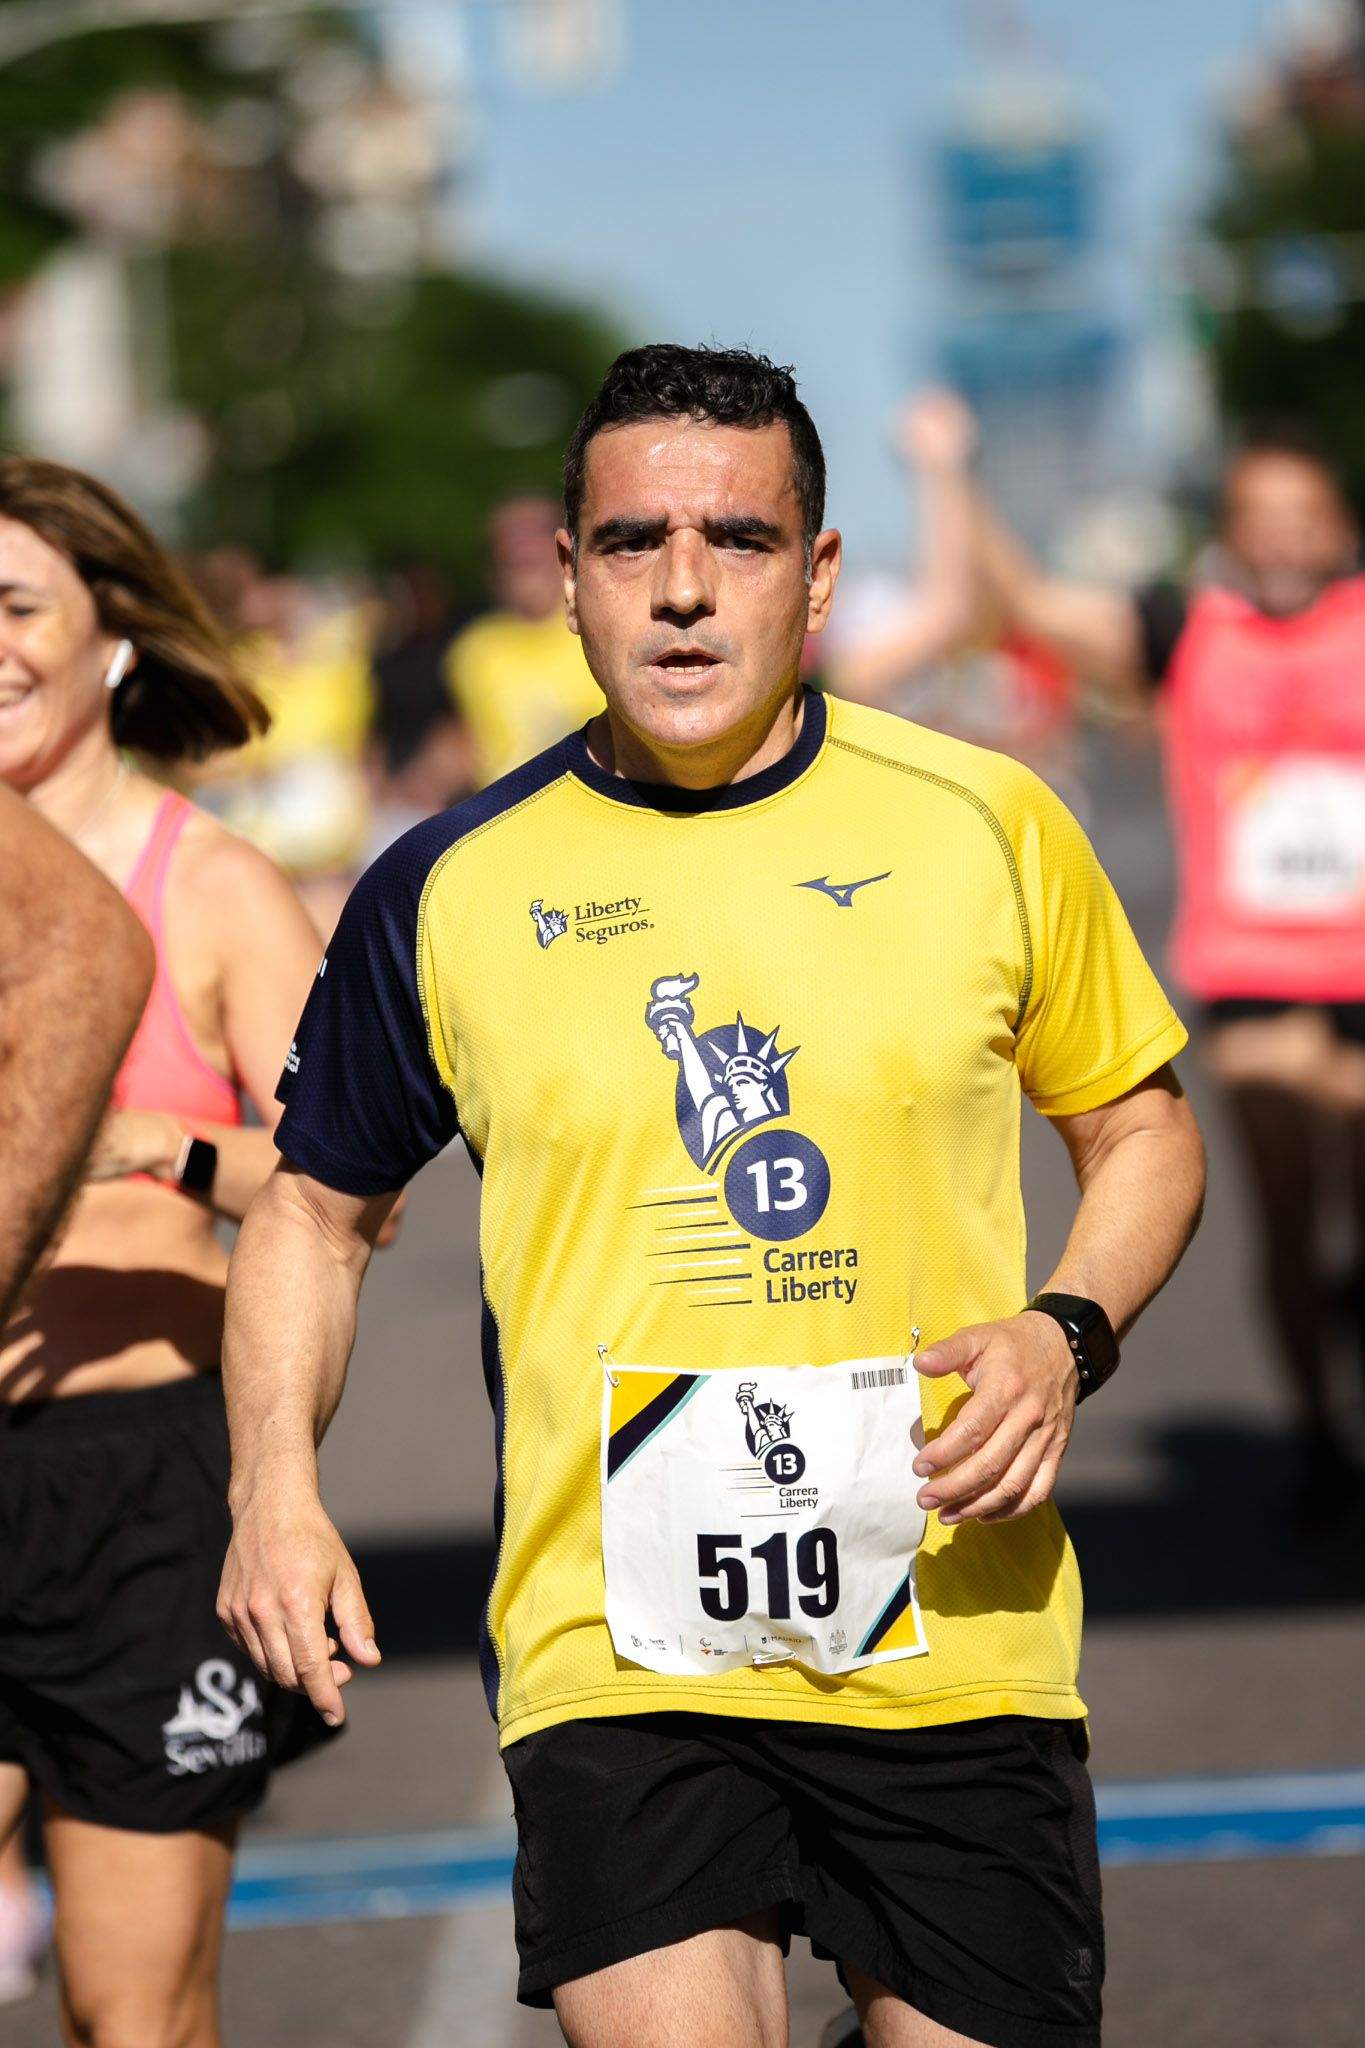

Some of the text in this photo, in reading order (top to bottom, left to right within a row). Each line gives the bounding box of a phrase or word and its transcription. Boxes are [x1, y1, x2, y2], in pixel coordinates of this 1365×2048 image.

[574, 896, 641, 921] Liberty
[746, 1156, 808, 1213] 13
[763, 1246, 858, 1273] Carrera
[765, 1275, 858, 1304] Liberty
[772, 1452, 798, 1476] 13
[779, 1487, 819, 1497] Carrera
[780, 1498, 819, 1509] Liberty
[696, 1526, 840, 1622] 519
